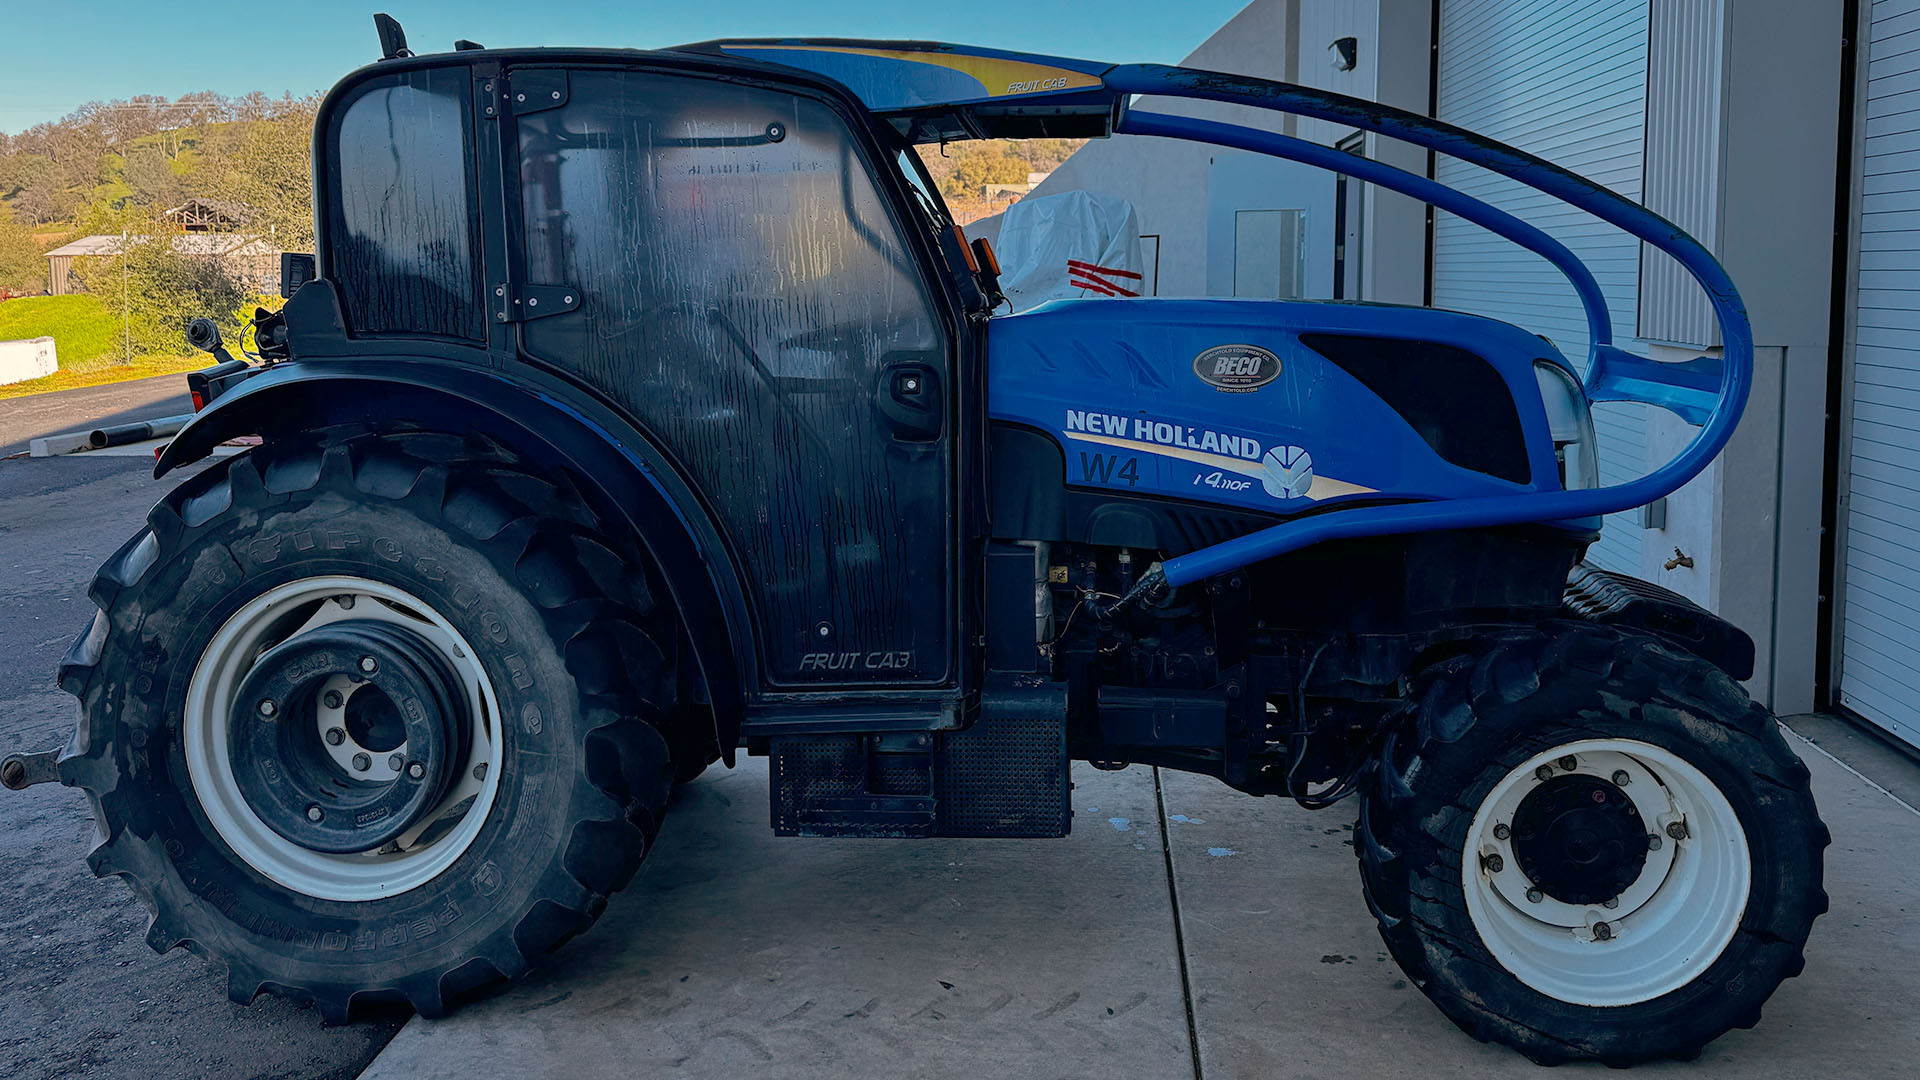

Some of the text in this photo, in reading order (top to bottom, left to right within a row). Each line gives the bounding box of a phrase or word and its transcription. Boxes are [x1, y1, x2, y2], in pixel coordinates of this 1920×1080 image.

[1007, 77, 1068, 94] FRUIT CAB
[1213, 356, 1262, 376] BECO
[1067, 409, 1261, 460] NEW HOLLAND
[1080, 451, 1139, 487] W4
[799, 651, 911, 671] FRUIT CAB
